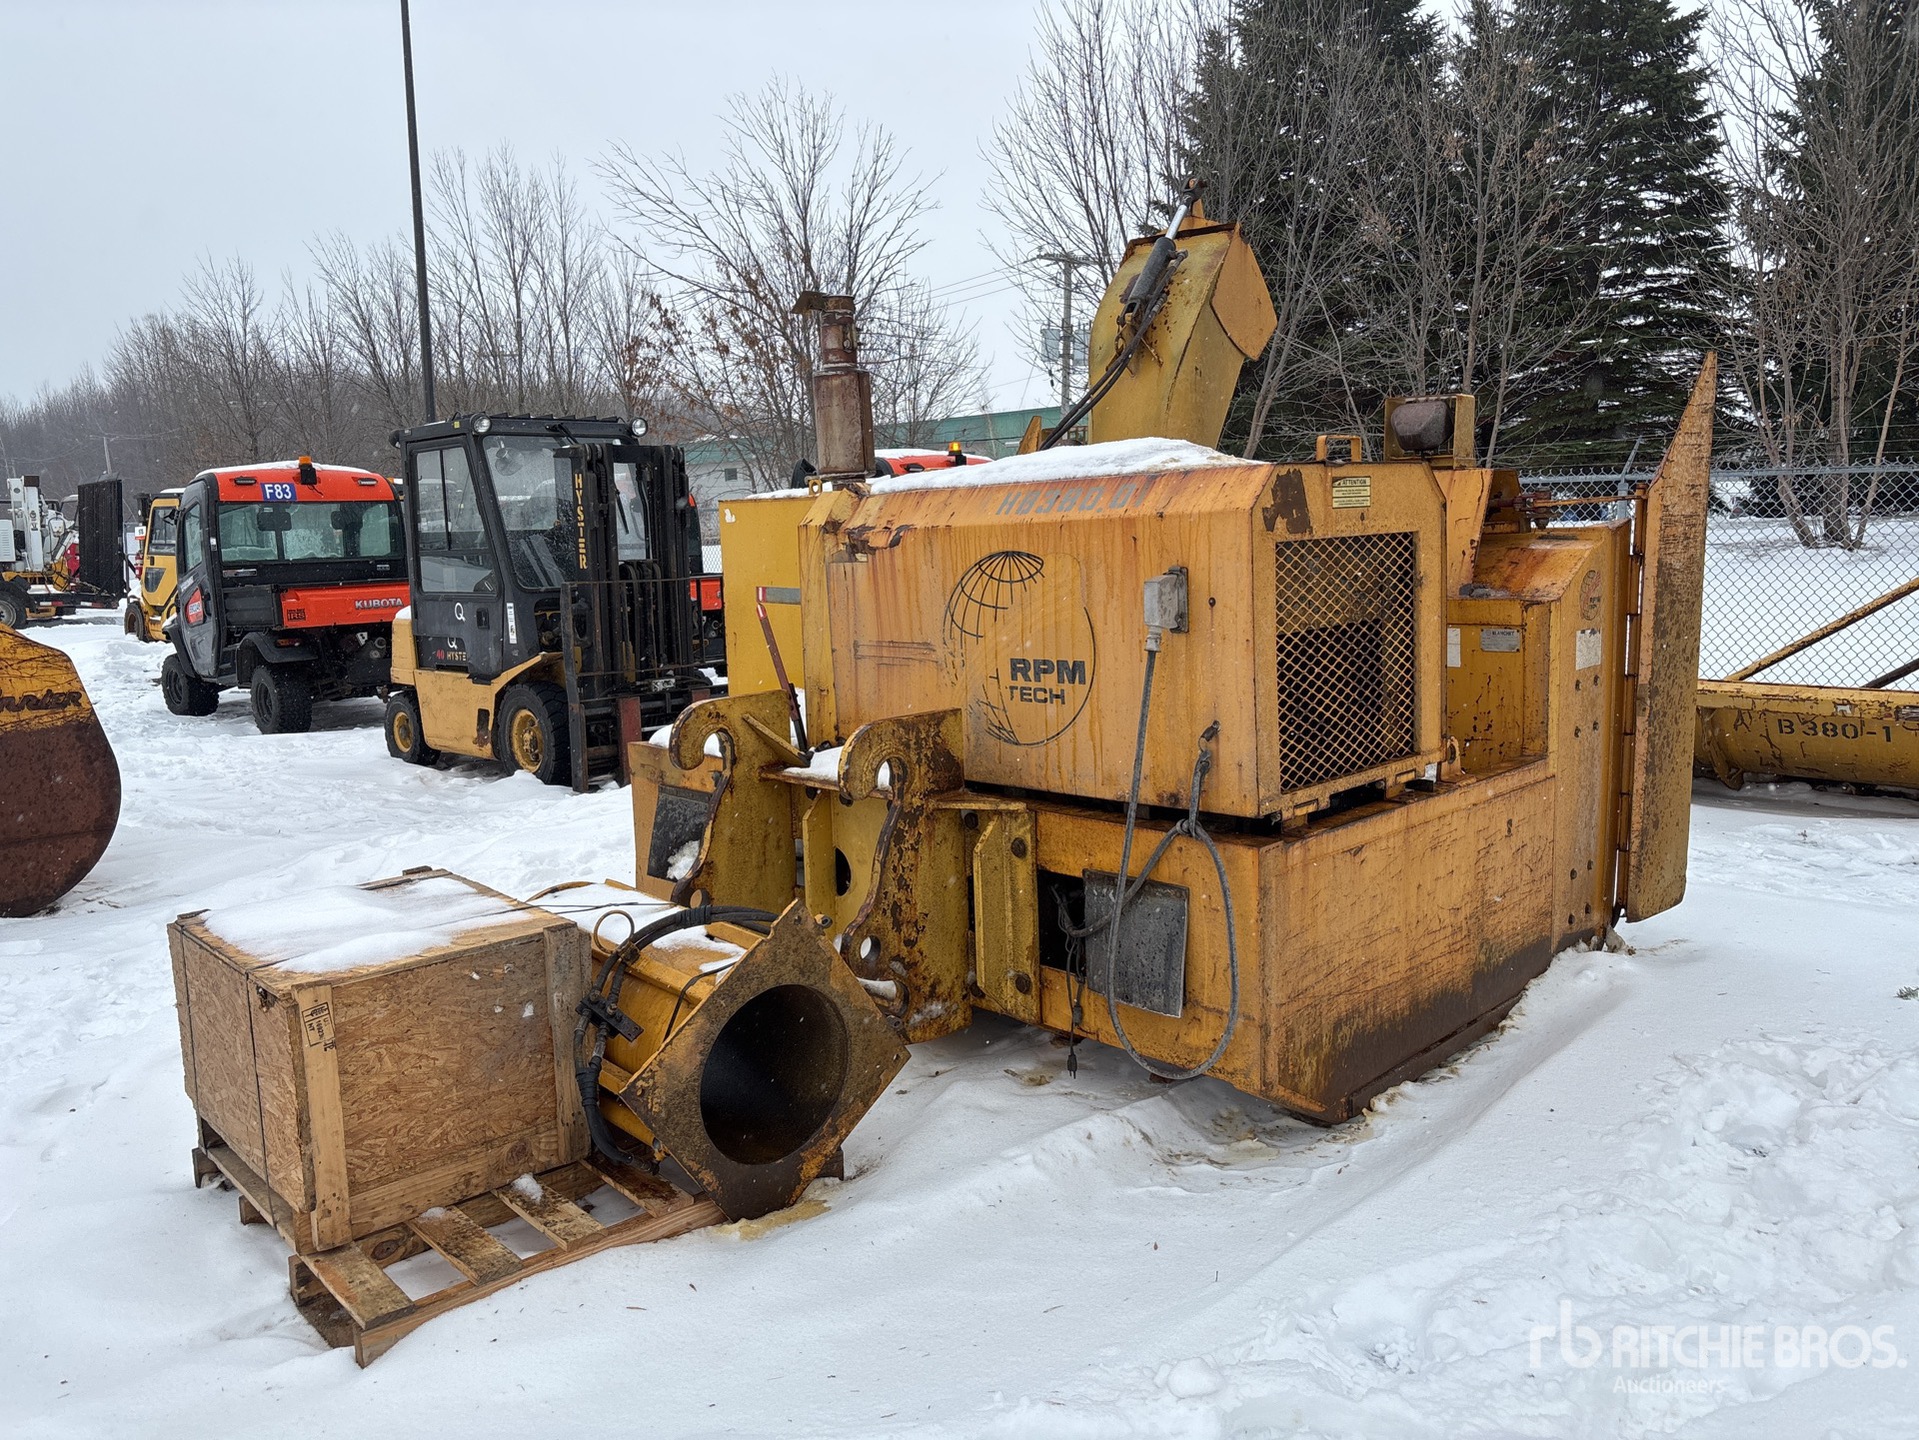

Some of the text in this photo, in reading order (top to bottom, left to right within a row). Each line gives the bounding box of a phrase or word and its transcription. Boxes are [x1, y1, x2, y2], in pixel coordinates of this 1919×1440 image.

[264, 484, 292, 499] F83
[574, 473, 588, 569] HYSTER
[355, 598, 403, 609] KUBOTA
[454, 602, 466, 622] Q
[447, 651, 467, 661] HYSTE
[1010, 658, 1087, 685] RPM
[1008, 686, 1066, 705] TECH
